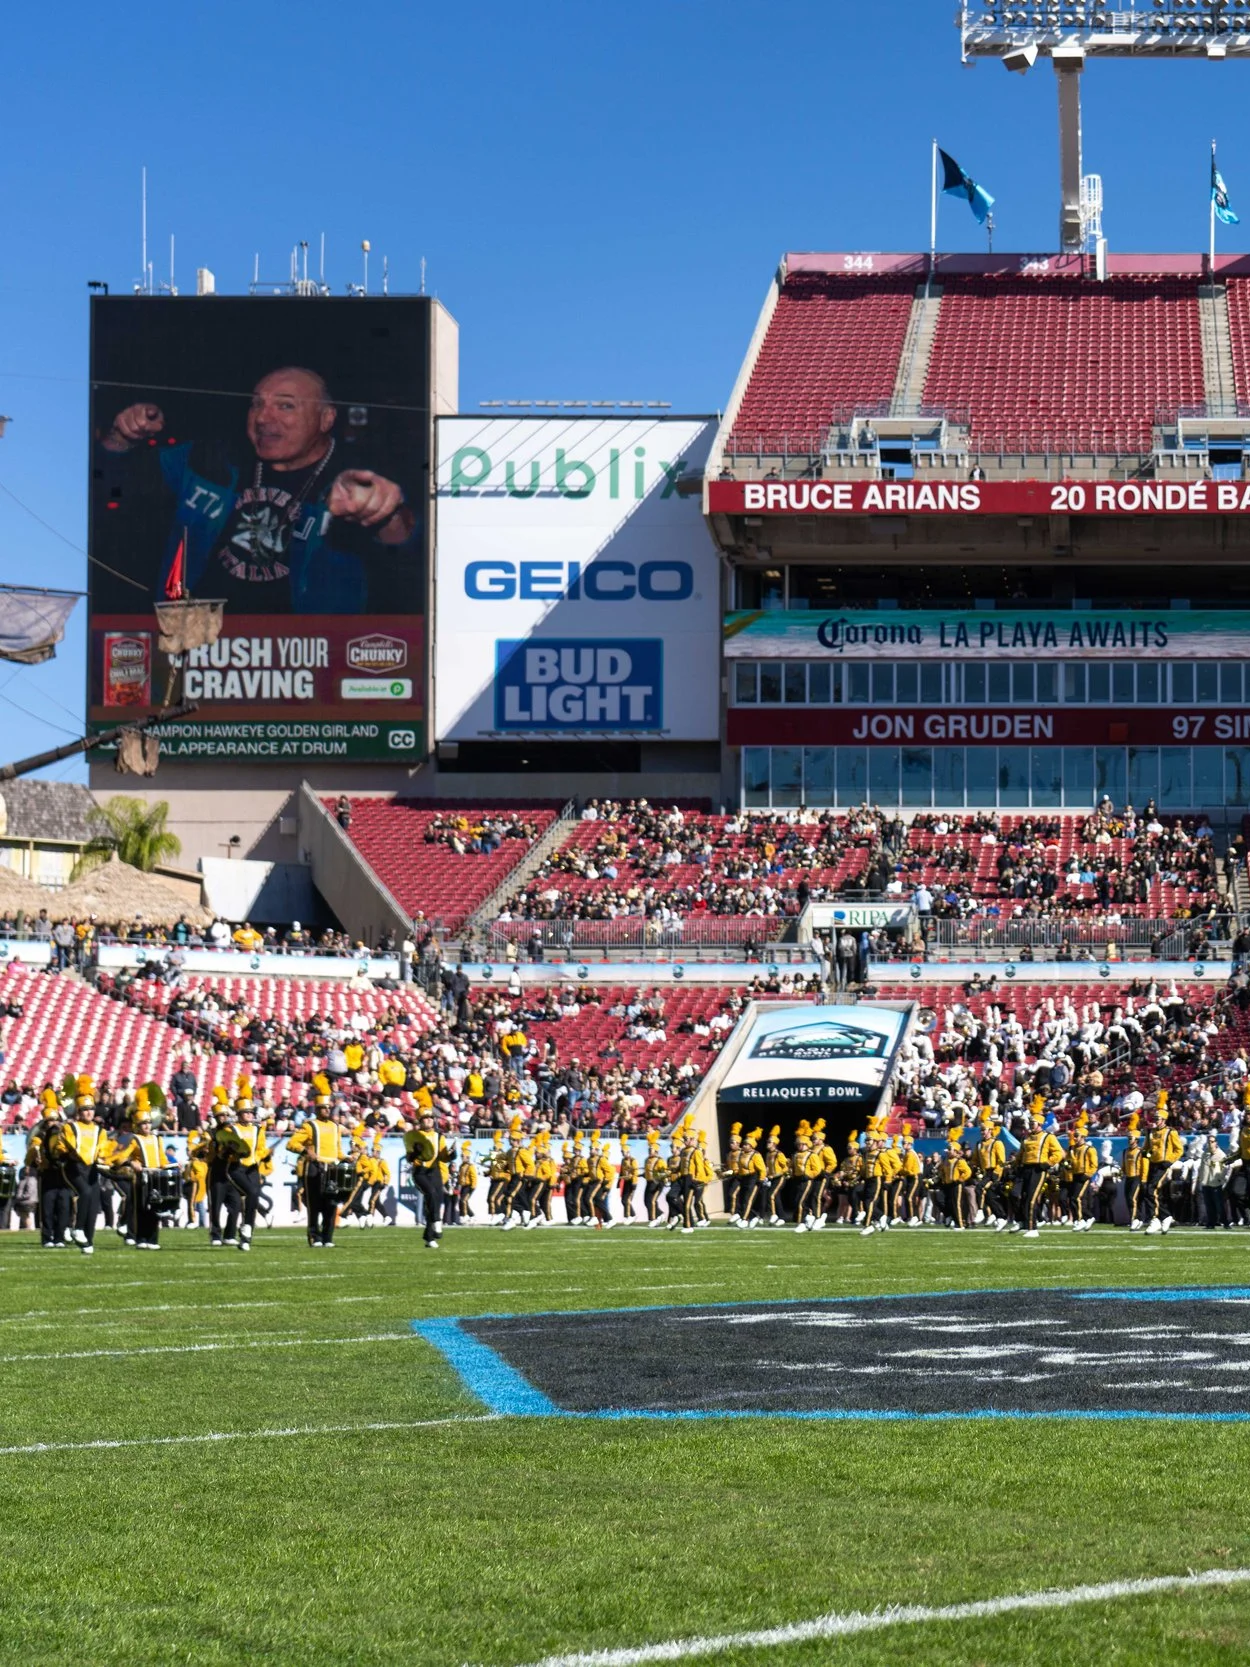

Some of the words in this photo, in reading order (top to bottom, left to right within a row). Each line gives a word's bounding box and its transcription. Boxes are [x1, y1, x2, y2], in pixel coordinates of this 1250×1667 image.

[843, 255, 874, 269] 344
[450, 446, 690, 500] Publix
[743, 483, 853, 510] BRUCE
[862, 483, 981, 511] ARIANS
[1050, 485, 1086, 511] 20
[1095, 480, 1208, 511] RONDÉ
[463, 560, 695, 601] GEICO
[817, 617, 924, 653] Corona
[939, 621, 970, 648] LA
[979, 621, 1058, 648] PLAYA
[1068, 620, 1169, 648] AWAITS
[278, 637, 328, 667] YOUR
[350, 647, 403, 663] CHUNKY
[525, 648, 632, 684] BUD
[184, 670, 314, 699] CRAVING
[504, 685, 652, 722] LIGHT
[142, 725, 201, 738] HAMPION
[204, 725, 264, 738] HAWKEYE
[267, 725, 319, 738] GOLDEN
[322, 725, 350, 738] GIRL
[351, 725, 379, 738] AND
[390, 732, 414, 747] CC
[852, 715, 915, 739] JON
[924, 714, 1053, 739] GRUDEN
[1172, 715, 1205, 739] 97
[179, 742, 278, 755] APPEARANCE
[281, 742, 299, 755] AT
[305, 742, 347, 755] DRUM
[848, 910, 890, 926] RIPA
[743, 1087, 822, 1098] RELIAQUEST
[828, 1086, 863, 1097] BOWL
